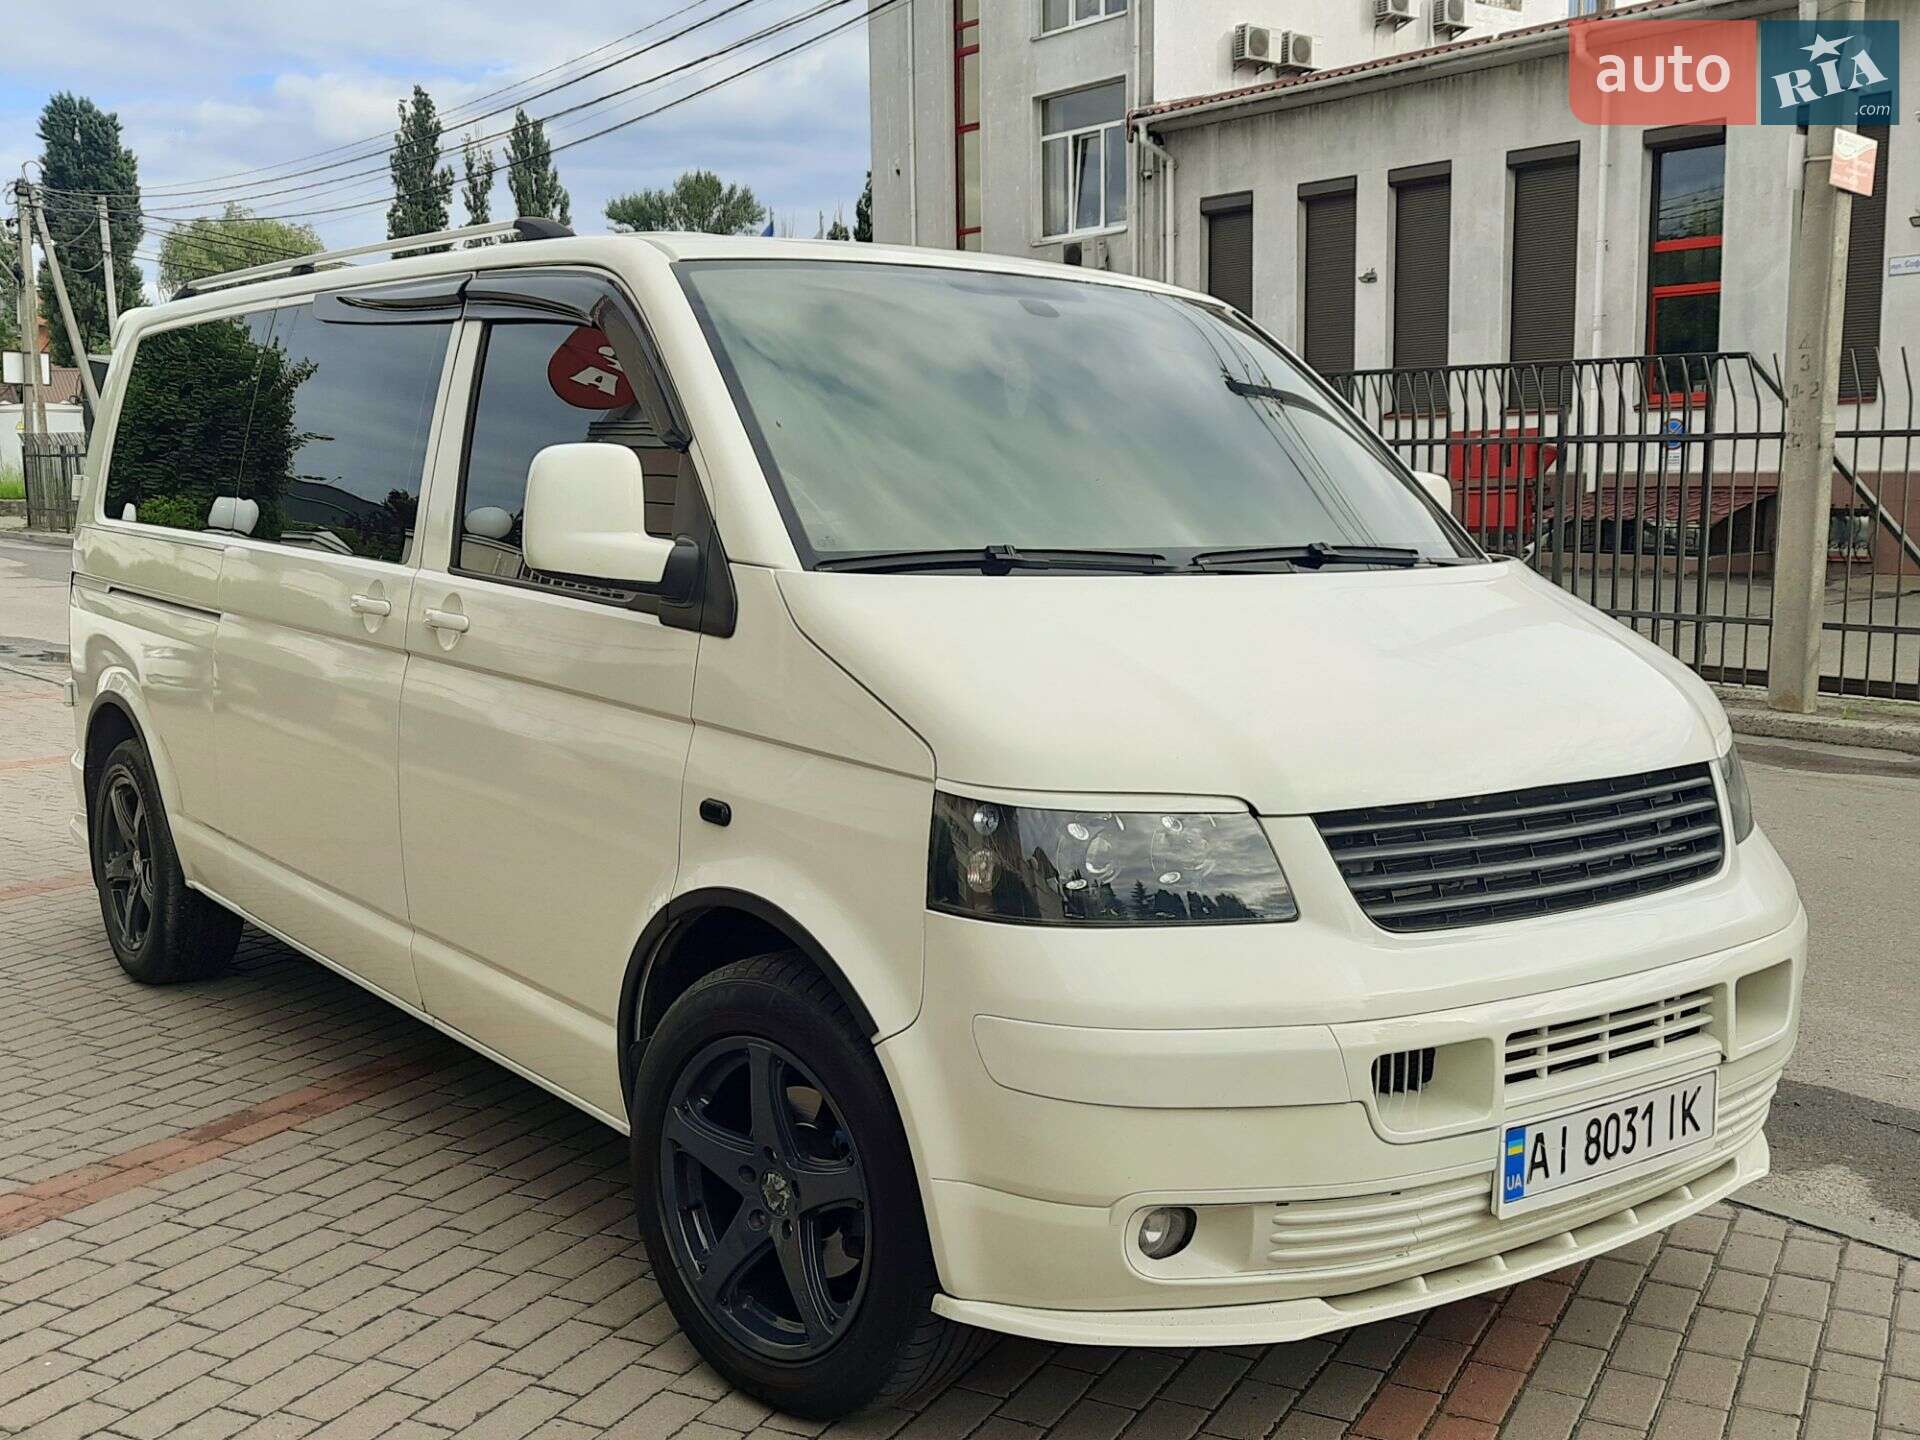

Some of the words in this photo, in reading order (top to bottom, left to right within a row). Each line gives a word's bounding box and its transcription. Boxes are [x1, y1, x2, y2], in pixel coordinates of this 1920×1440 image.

[1527, 1126, 1567, 1184] AI
[1585, 1101, 1654, 1165] 8031
[1669, 1086, 1702, 1140] IK
[1507, 1175, 1522, 1190] UA
